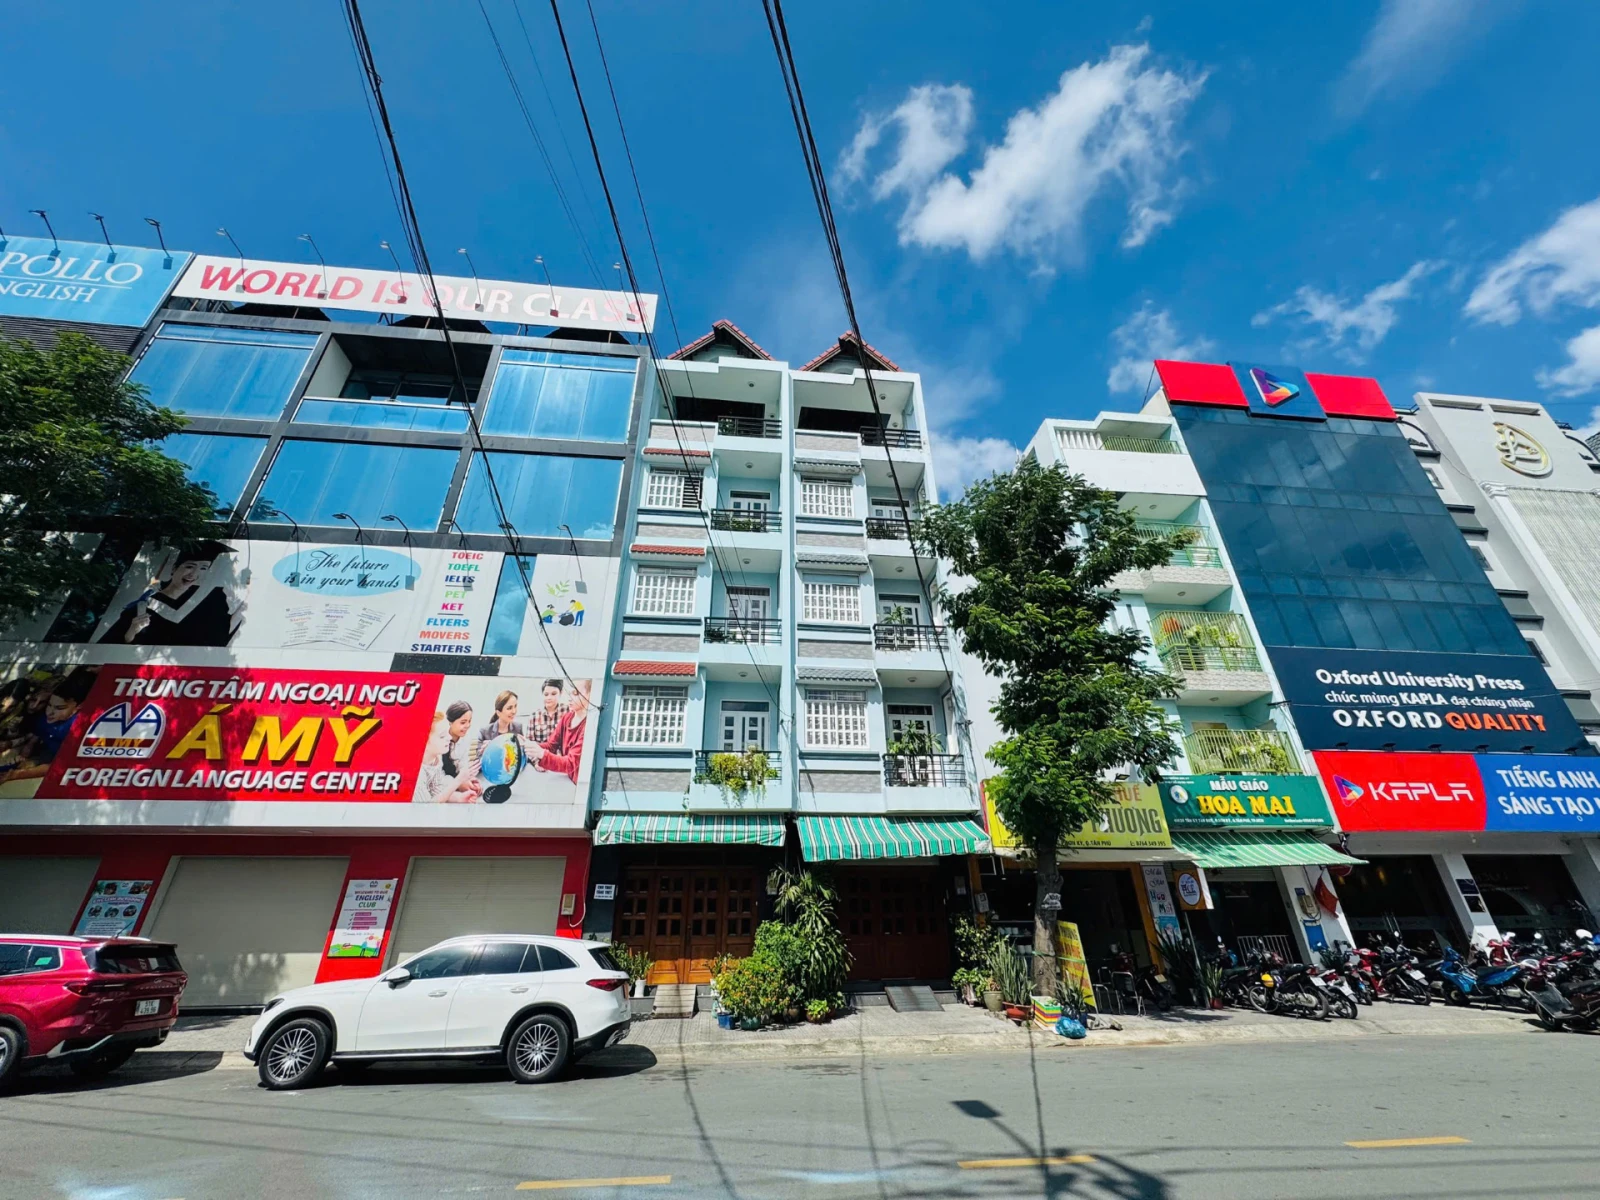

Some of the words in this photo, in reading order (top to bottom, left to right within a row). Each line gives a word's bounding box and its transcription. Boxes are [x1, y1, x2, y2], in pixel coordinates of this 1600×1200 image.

[200, 265, 364, 301] WORLD
[371, 279, 414, 305] IS
[422, 284, 513, 314] OUR
[523, 293, 648, 324] CLASS
[305, 550, 341, 571] The
[341, 555, 389, 573] future
[452, 551, 484, 560] TOEIC
[447, 562, 480, 572] TOEFL
[284, 572, 297, 584] is
[299, 574, 316, 585] in
[317, 576, 354, 589] your
[357, 573, 400, 588] hands
[445, 575, 475, 583] IELTS
[444, 590, 467, 599] PET
[441, 603, 464, 611] KET
[426, 617, 470, 627] FLYERS
[419, 630, 470, 640] MOVERS
[410, 643, 472, 653] STARTERS
[1315, 668, 1383, 686] Oxford
[1383, 671, 1475, 691] University
[1475, 674, 1525, 690] Press
[113, 678, 206, 698] TRUNG
[208, 675, 266, 700] TÂM
[268, 681, 355, 707] NGOẠI
[358, 680, 421, 704] NGỮ
[1324, 690, 1358, 703] chúc
[1359, 691, 1400, 706] mừng
[1398, 692, 1448, 705] KAPLA
[1450, 696, 1470, 708] đạt
[1470, 696, 1507, 709] chứng
[1507, 698, 1534, 711] nhận
[1332, 709, 1443, 729] OXFORD
[1444, 711, 1547, 733] QUALITY
[165, 703, 233, 760] Á
[241, 705, 383, 762] MỸ
[82, 747, 144, 757] SCHOOL
[60, 768, 172, 788] FOREIGN
[171, 769, 308, 791] LANGUAGE
[311, 772, 402, 792] CENTER
[1238, 778, 1269, 791] GIÁO
[1495, 764, 1557, 788] TIẾNG
[1556, 770, 1600, 789] ANH
[1368, 781, 1475, 802] KAPLA
[1197, 795, 1246, 815] HOA
[1247, 795, 1296, 815] MAI
[1498, 791, 1555, 815] SÁNG
[1551, 796, 1595, 822] TẠO
